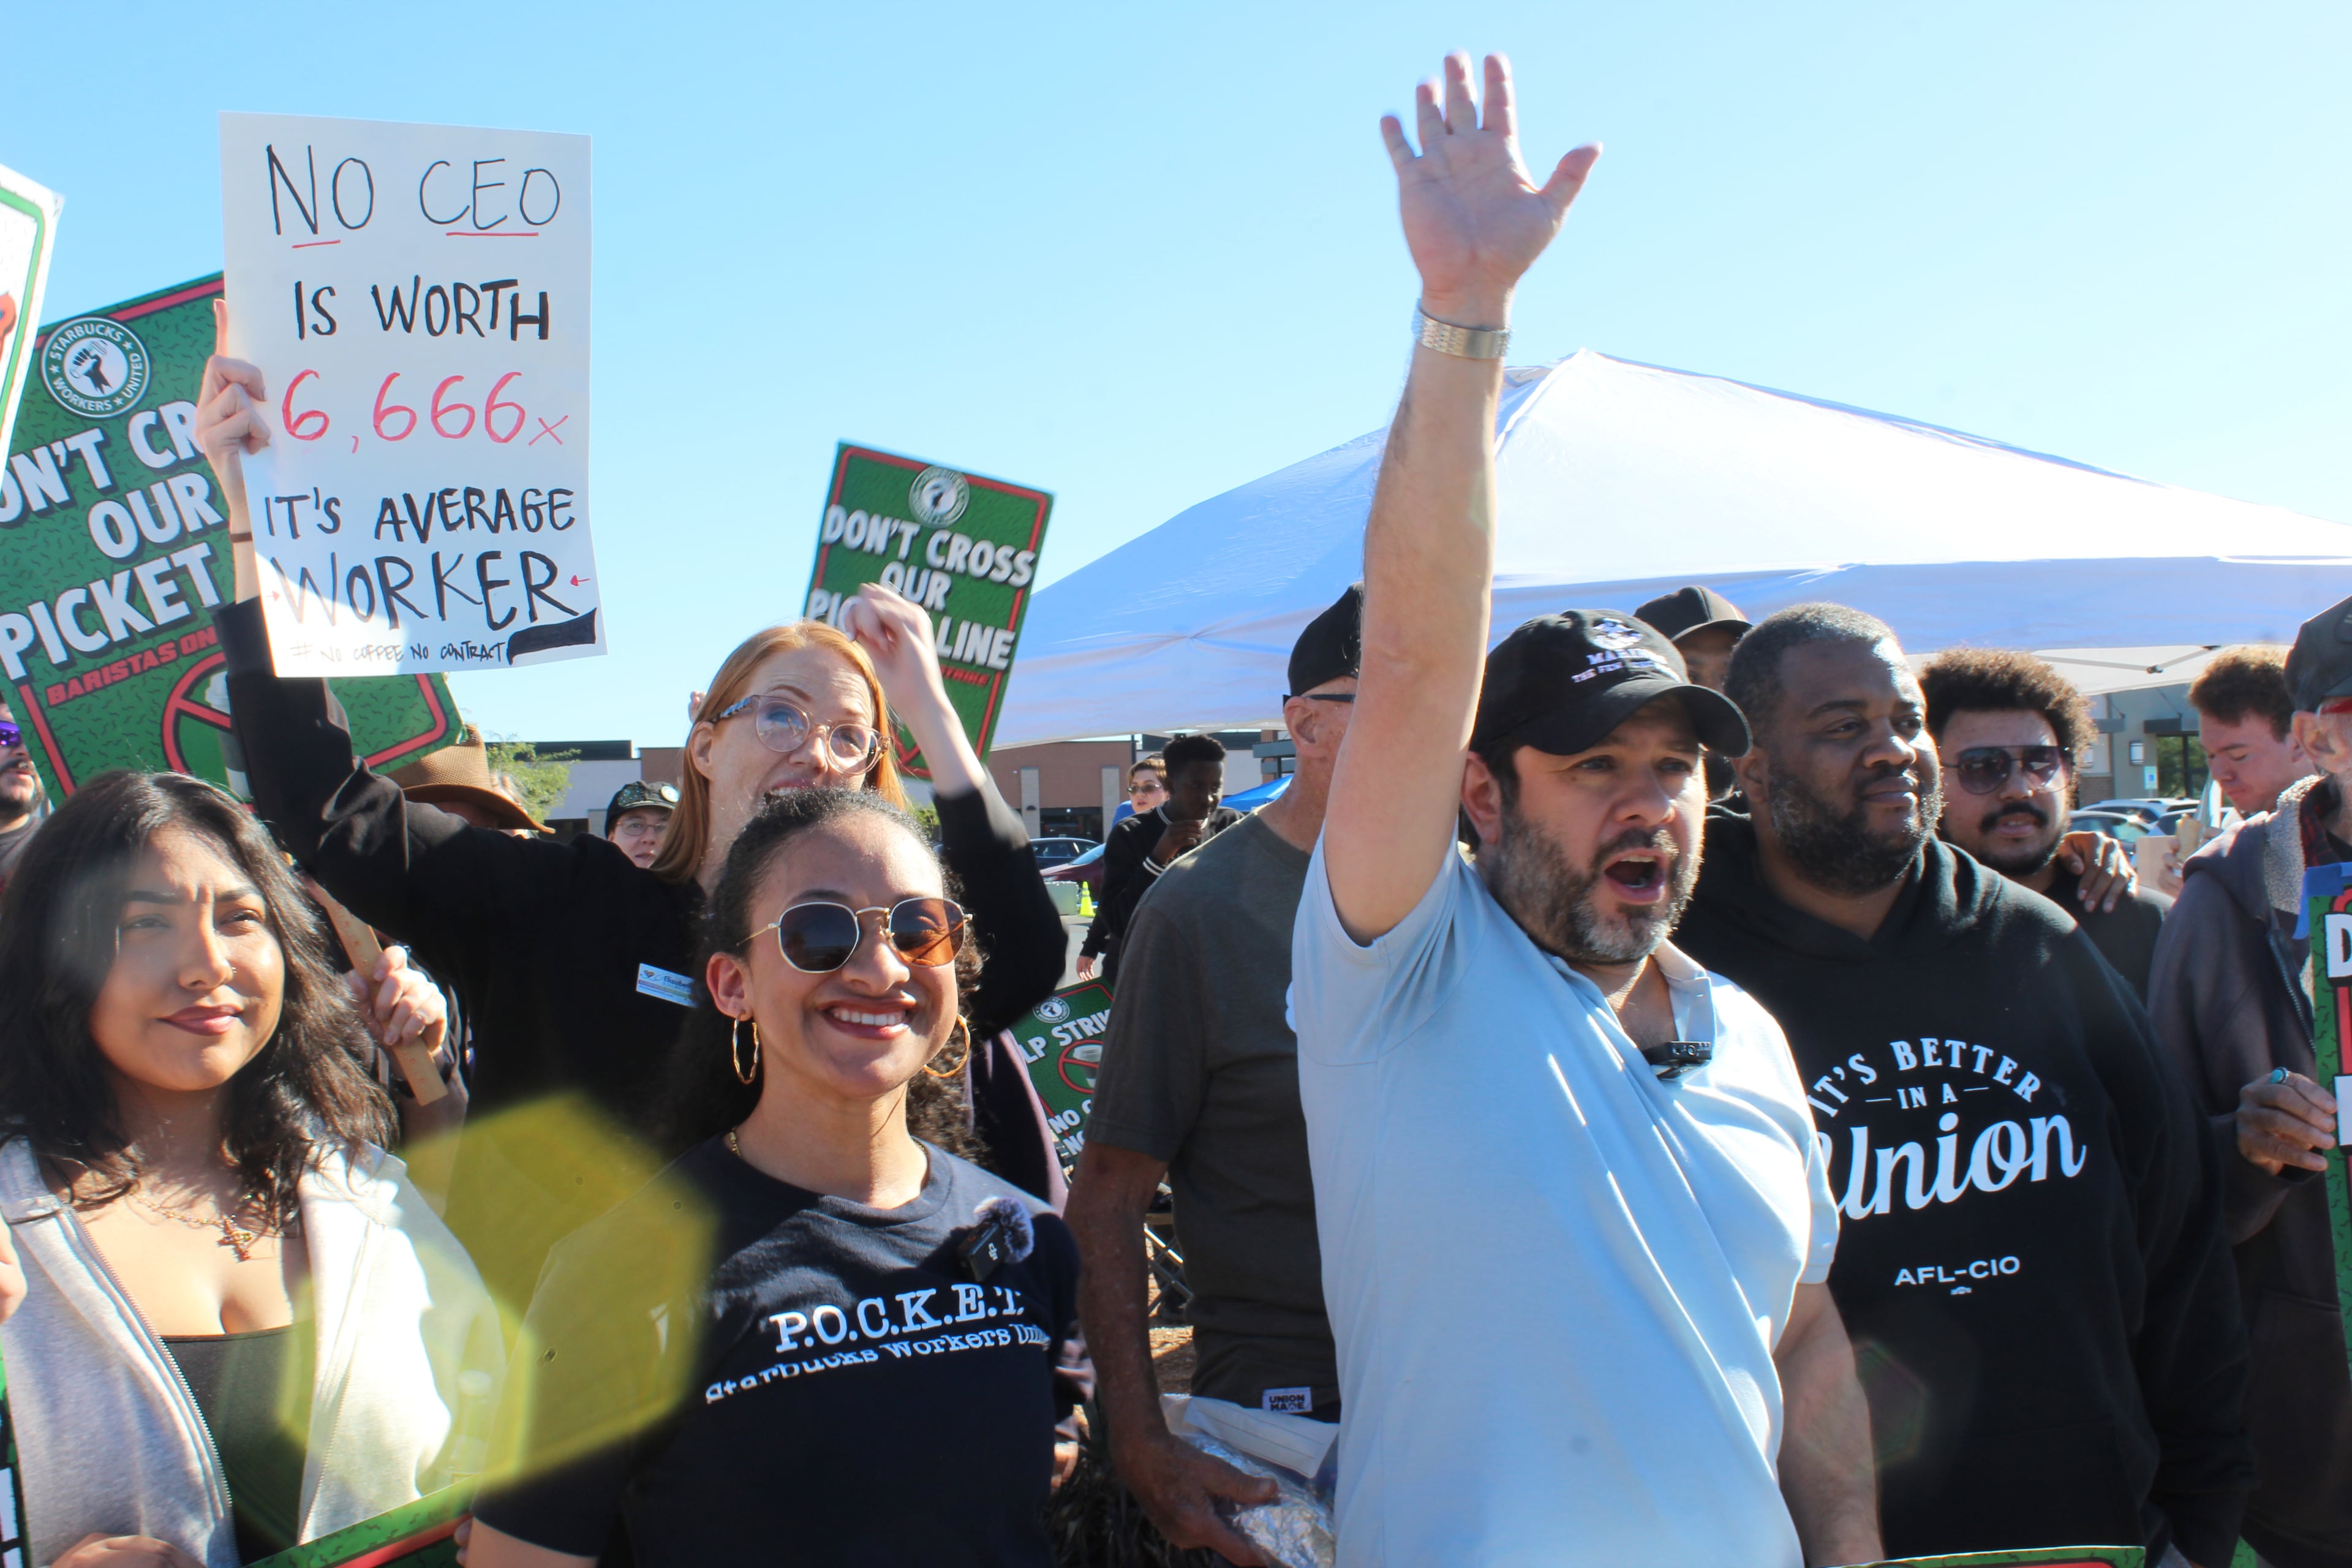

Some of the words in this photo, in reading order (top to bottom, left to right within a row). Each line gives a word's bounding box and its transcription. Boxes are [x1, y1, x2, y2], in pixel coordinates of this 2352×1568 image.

[266, 144, 374, 235] NO
[420, 158, 560, 230] CEO
[295, 281, 337, 341] IS
[371, 275, 549, 341] WORTH
[50, 324, 124, 360] STARBUCKS
[52, 377, 112, 411] WORKERS
[124, 353, 143, 399] UNITED
[88, 473, 224, 559] OUR
[265, 486, 342, 540] IT'S
[374, 486, 575, 544] AVERAGE
[821, 505, 920, 560] DON'T
[926, 530, 1036, 588] CROSS
[0, 542, 221, 680] PICKET
[270, 551, 579, 631] WORKER
[880, 561, 952, 611] OUR
[46, 641, 178, 706] BARISTAS
[179, 626, 219, 655] ON
[353, 644, 404, 662] COFFEE
[410, 643, 429, 660] NO
[440, 640, 506, 663] CONTRACT
[935, 616, 1016, 671] LINE
[1807, 1053, 1877, 1117] IT'S
[1890, 1038, 2041, 1102] BETTER
[1897, 1087, 1927, 1109] IN
[1942, 1083, 1958, 1104] A
[1048, 1109, 1080, 1134] NO
[1894, 1256, 2021, 1286] AFL-CIO
[879, 1325, 1011, 1359] Workers
[1268, 1393, 1305, 1403] UNION
